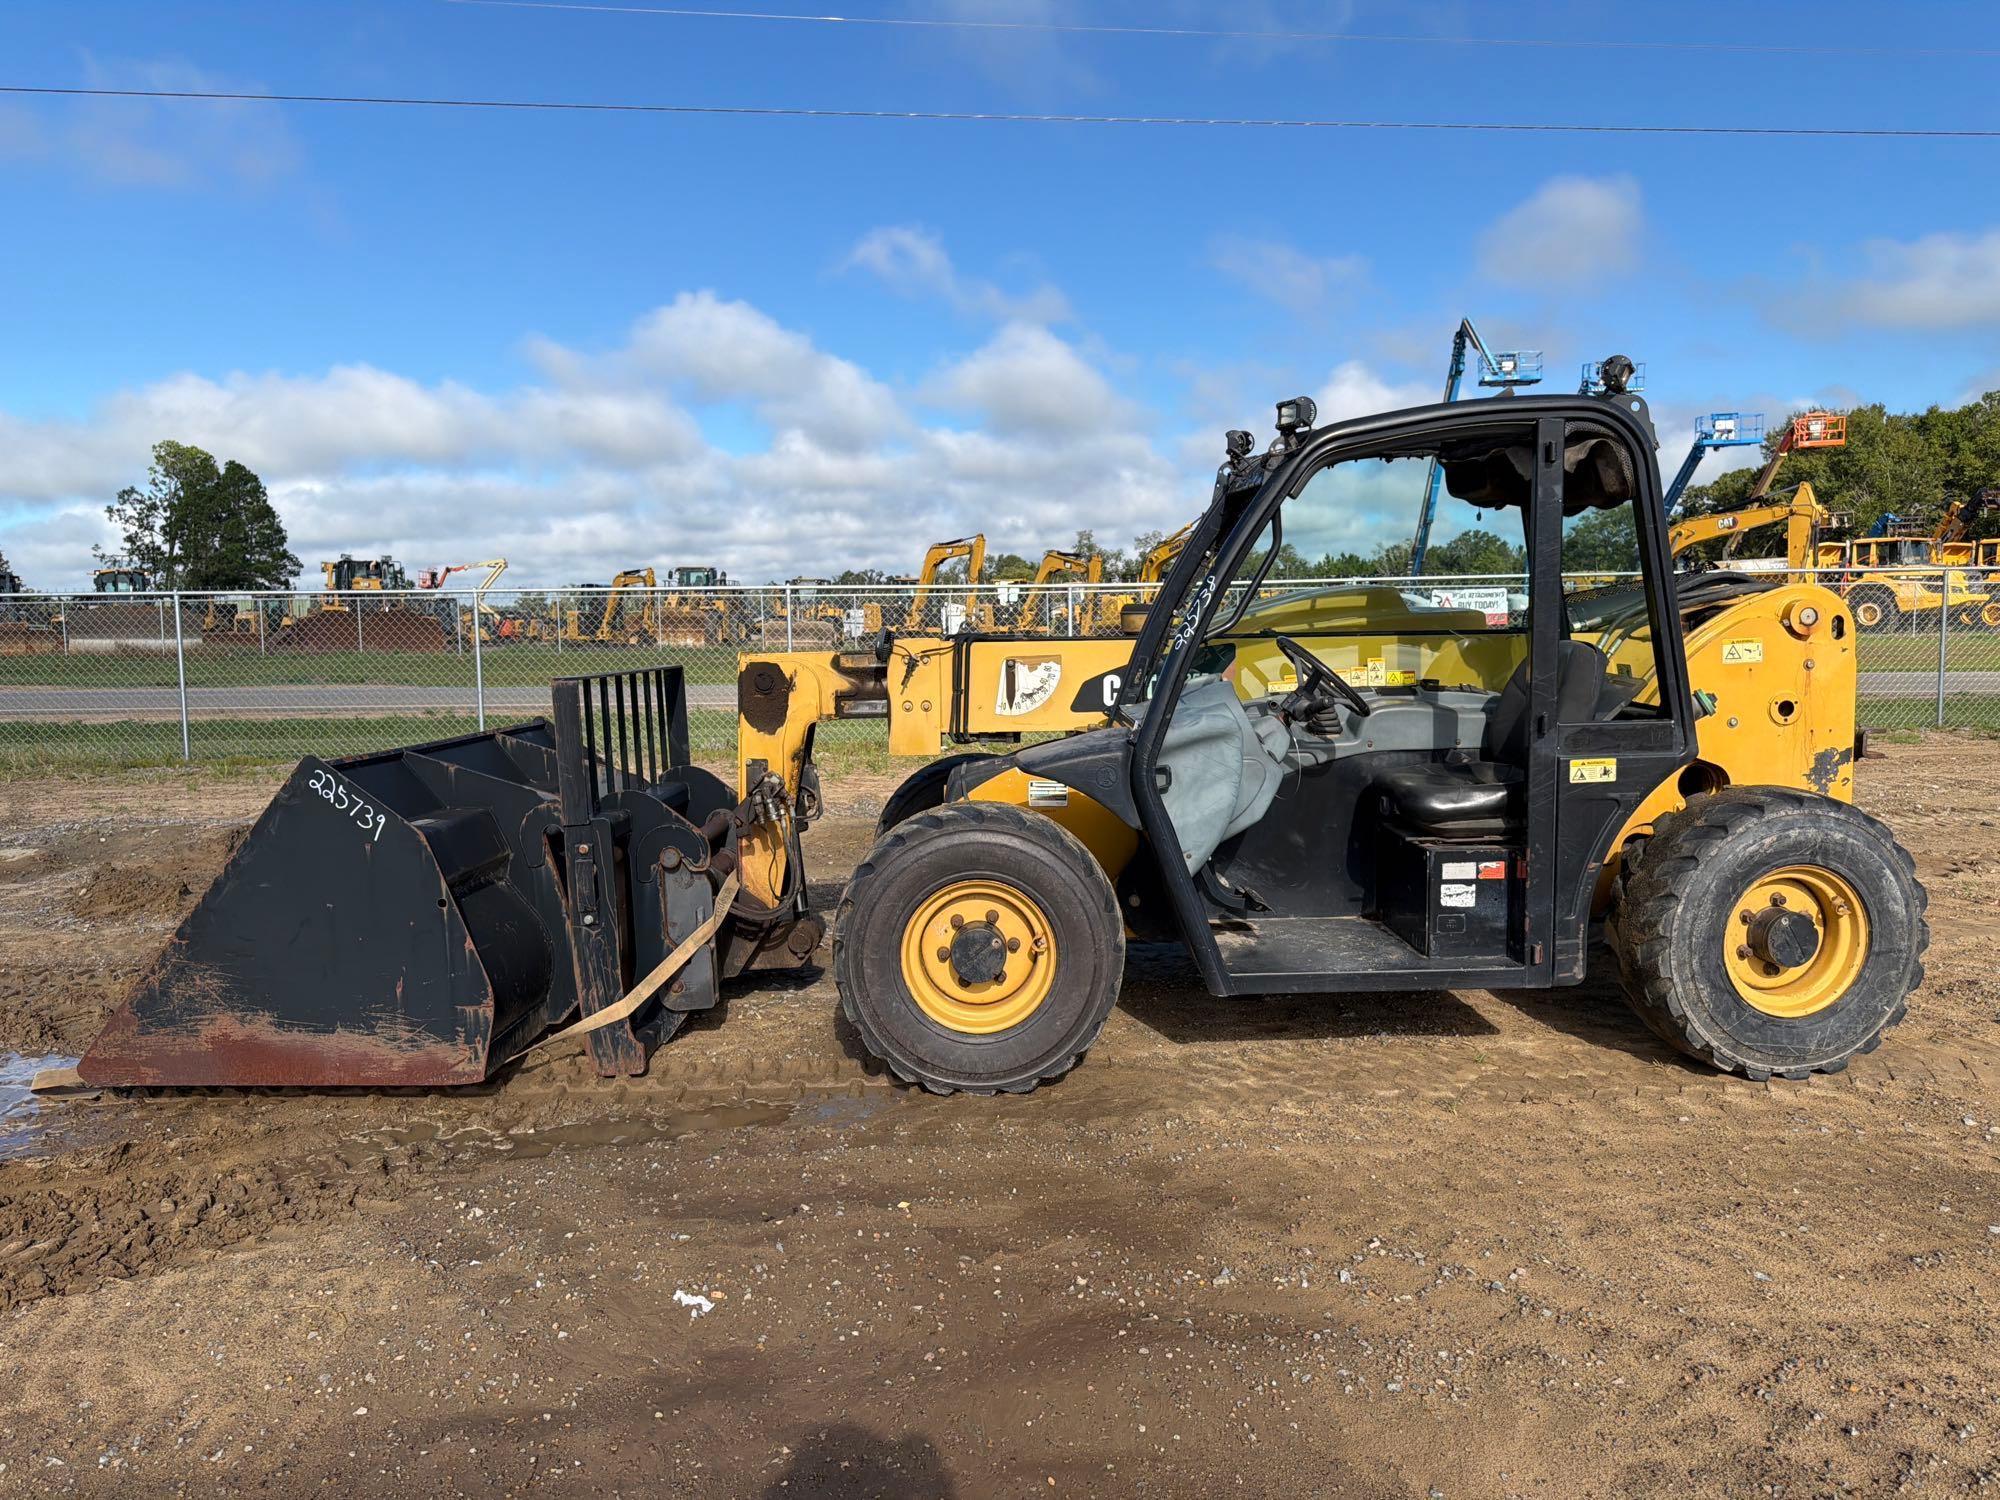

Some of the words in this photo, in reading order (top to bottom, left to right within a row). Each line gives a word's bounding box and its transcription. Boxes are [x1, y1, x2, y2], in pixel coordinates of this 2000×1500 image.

[1718, 516, 1734, 529] CAT
[1174, 575, 1217, 650] 225738
[308, 769, 386, 842] 225739
